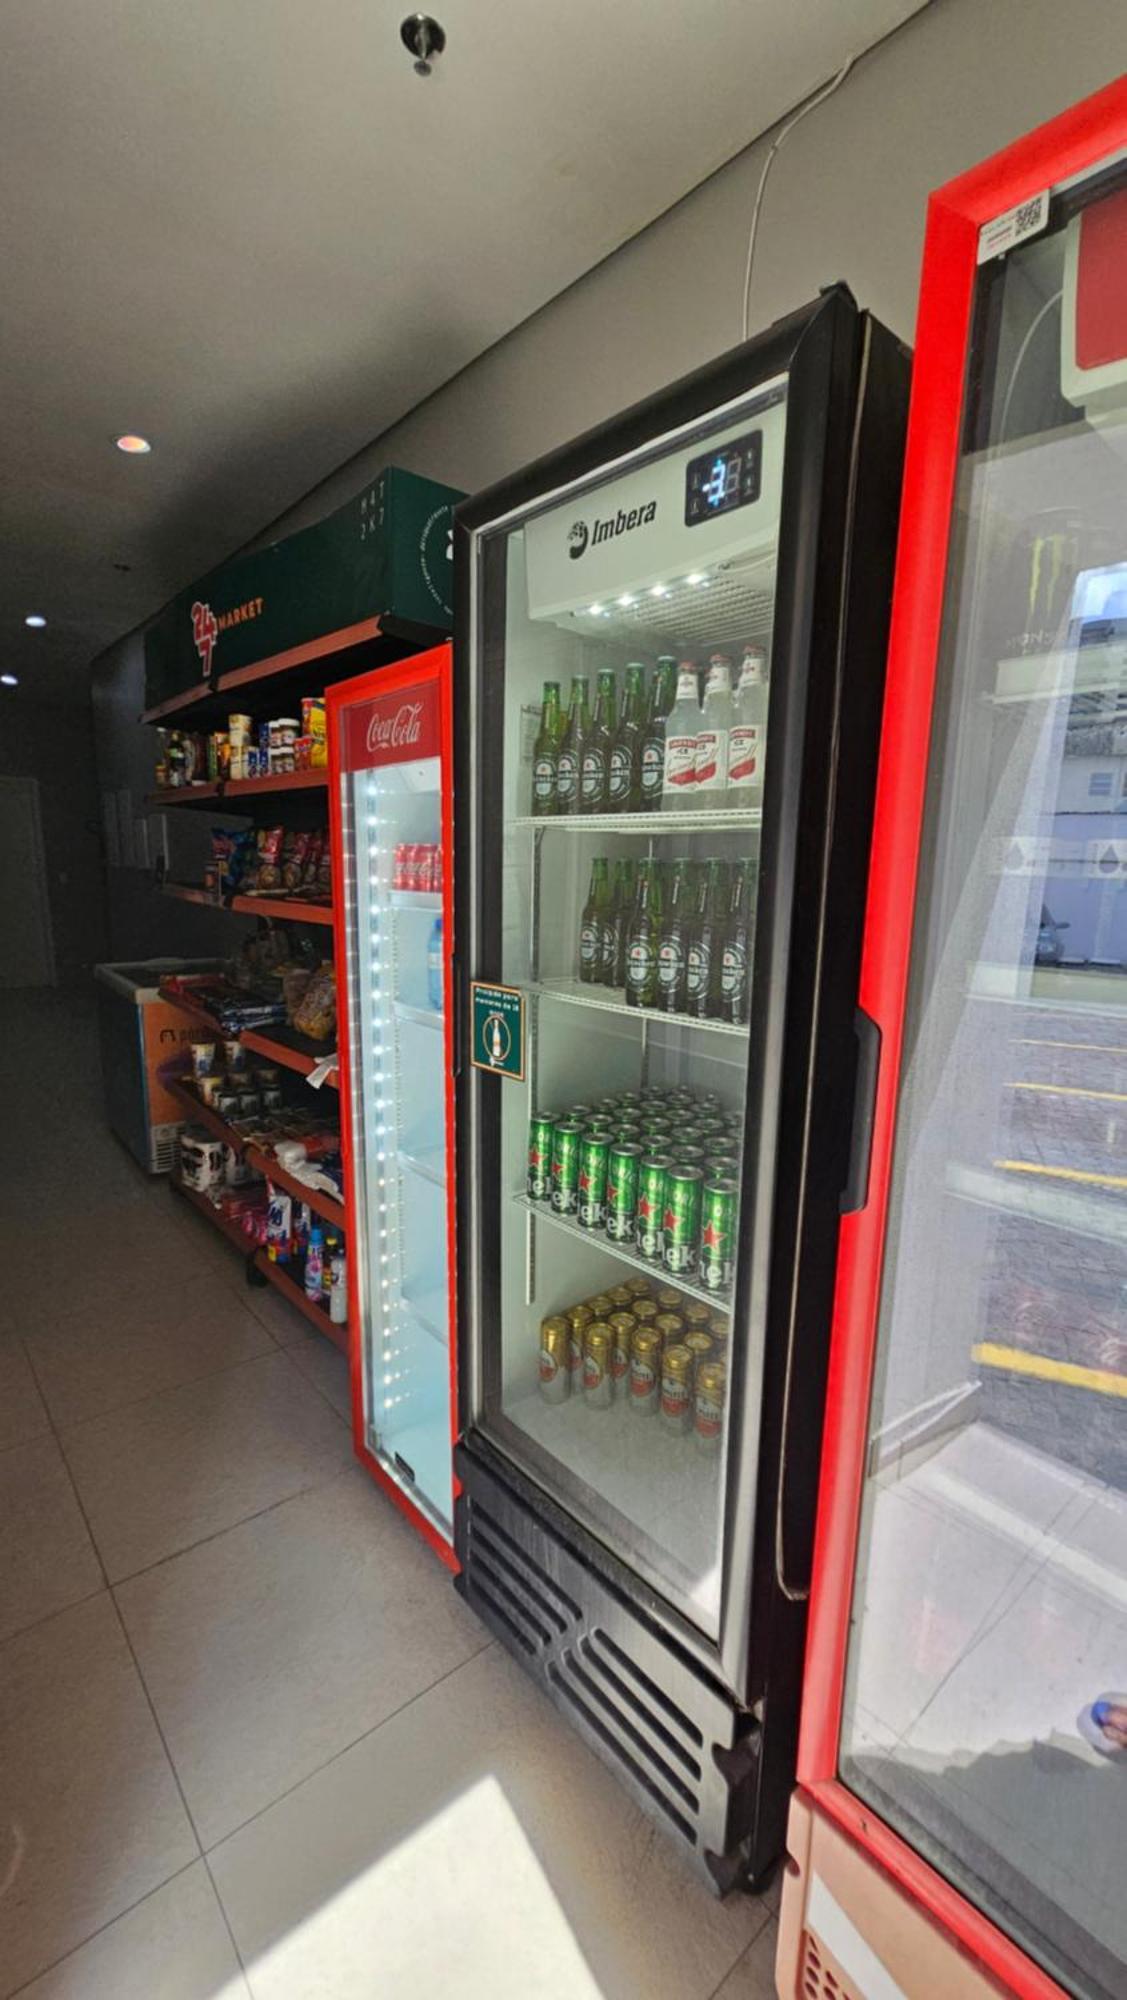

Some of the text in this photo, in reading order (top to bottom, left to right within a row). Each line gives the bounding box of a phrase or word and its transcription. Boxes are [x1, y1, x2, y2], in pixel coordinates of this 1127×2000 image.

[591, 501, 657, 546] Imbera
[218, 597, 264, 630] MARKET
[366, 700, 424, 752] Coca-Cola
